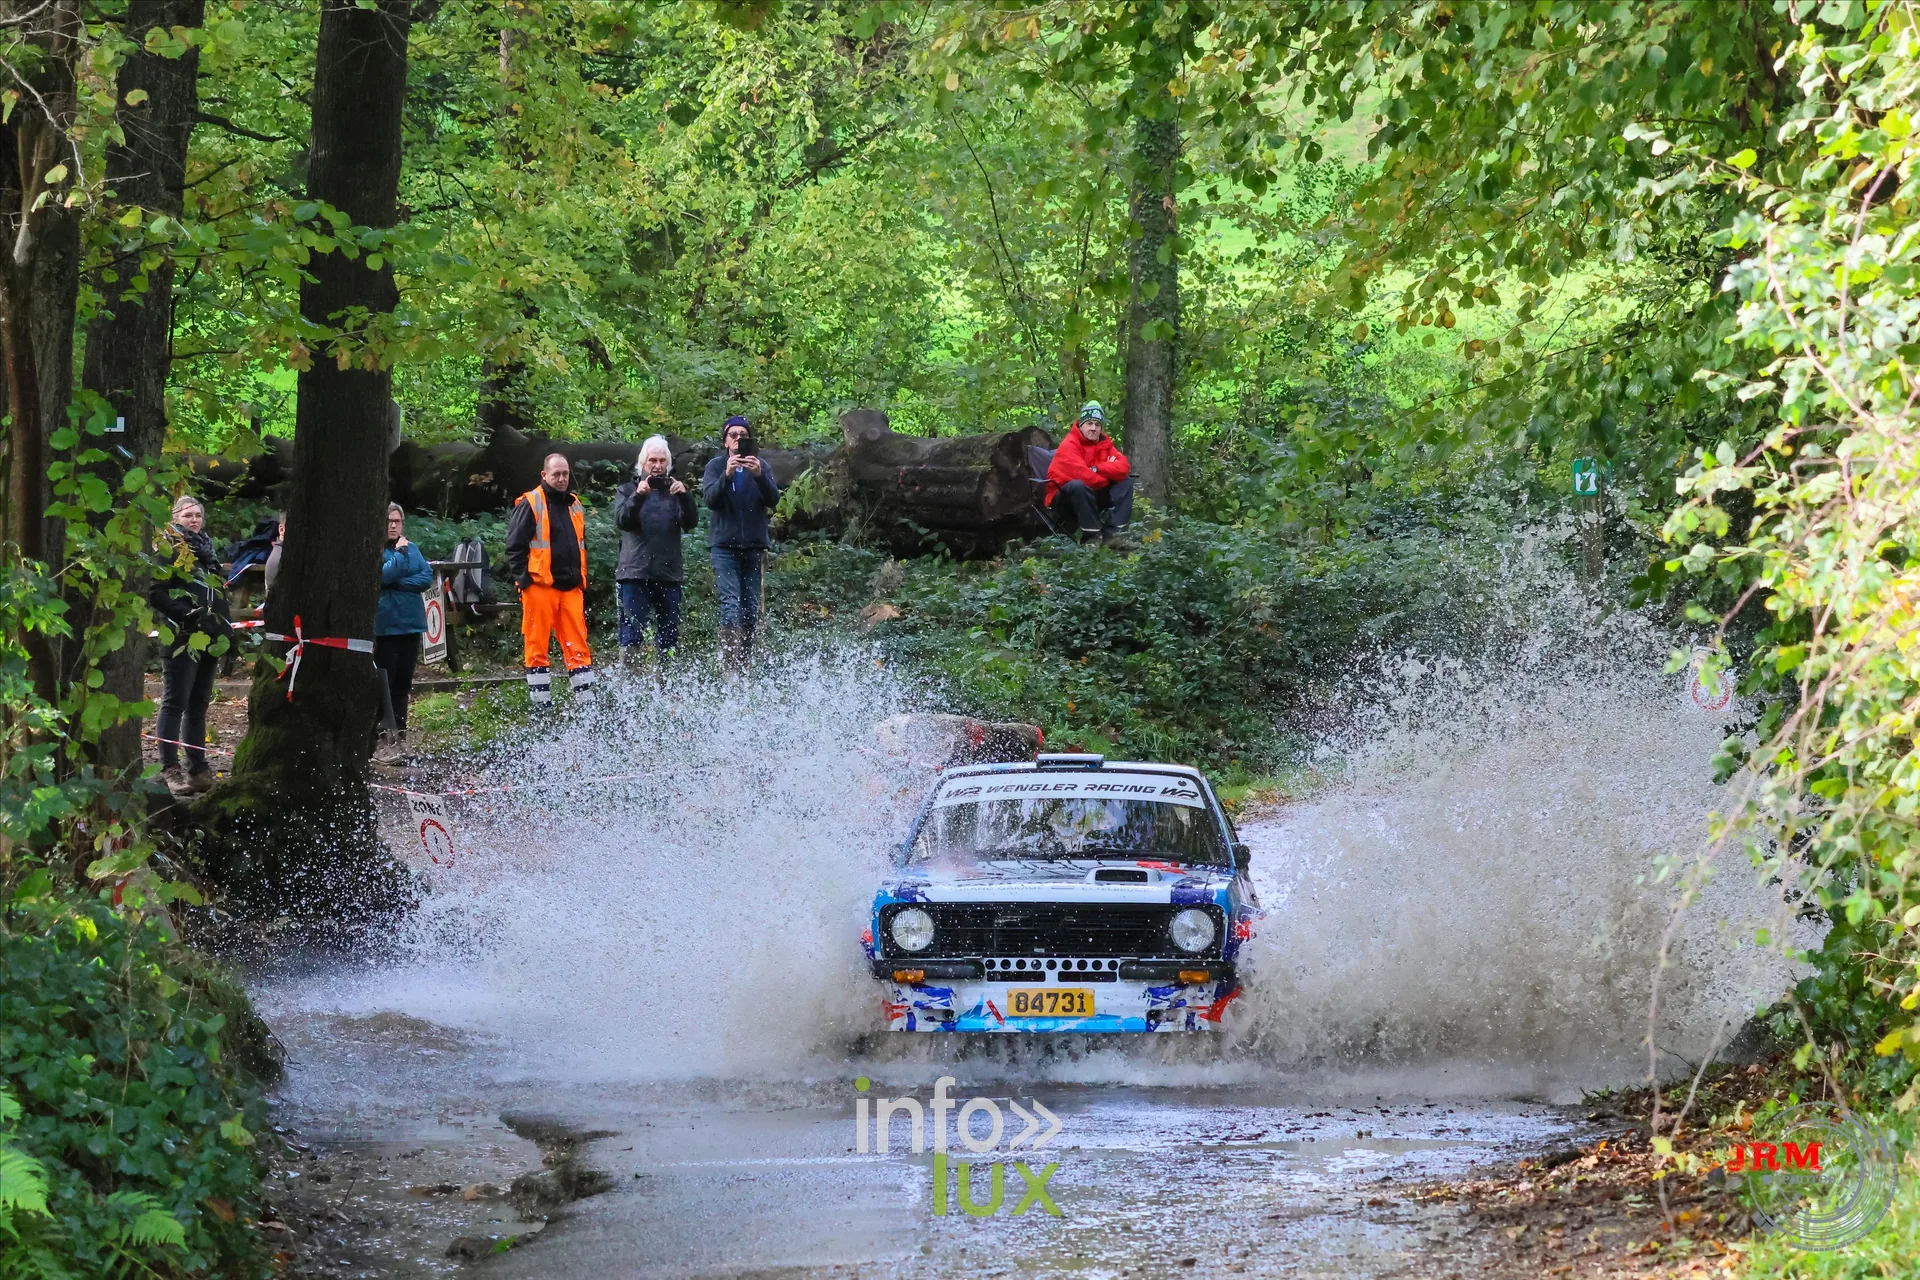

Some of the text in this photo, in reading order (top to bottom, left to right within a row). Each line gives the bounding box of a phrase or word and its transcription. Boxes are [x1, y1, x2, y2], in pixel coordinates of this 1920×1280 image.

[986, 783, 1078, 794] WENGLER
[1084, 783, 1157, 794] RACING
[411, 800, 443, 816] ZONE
[1015, 992, 1086, 1013] 84731
